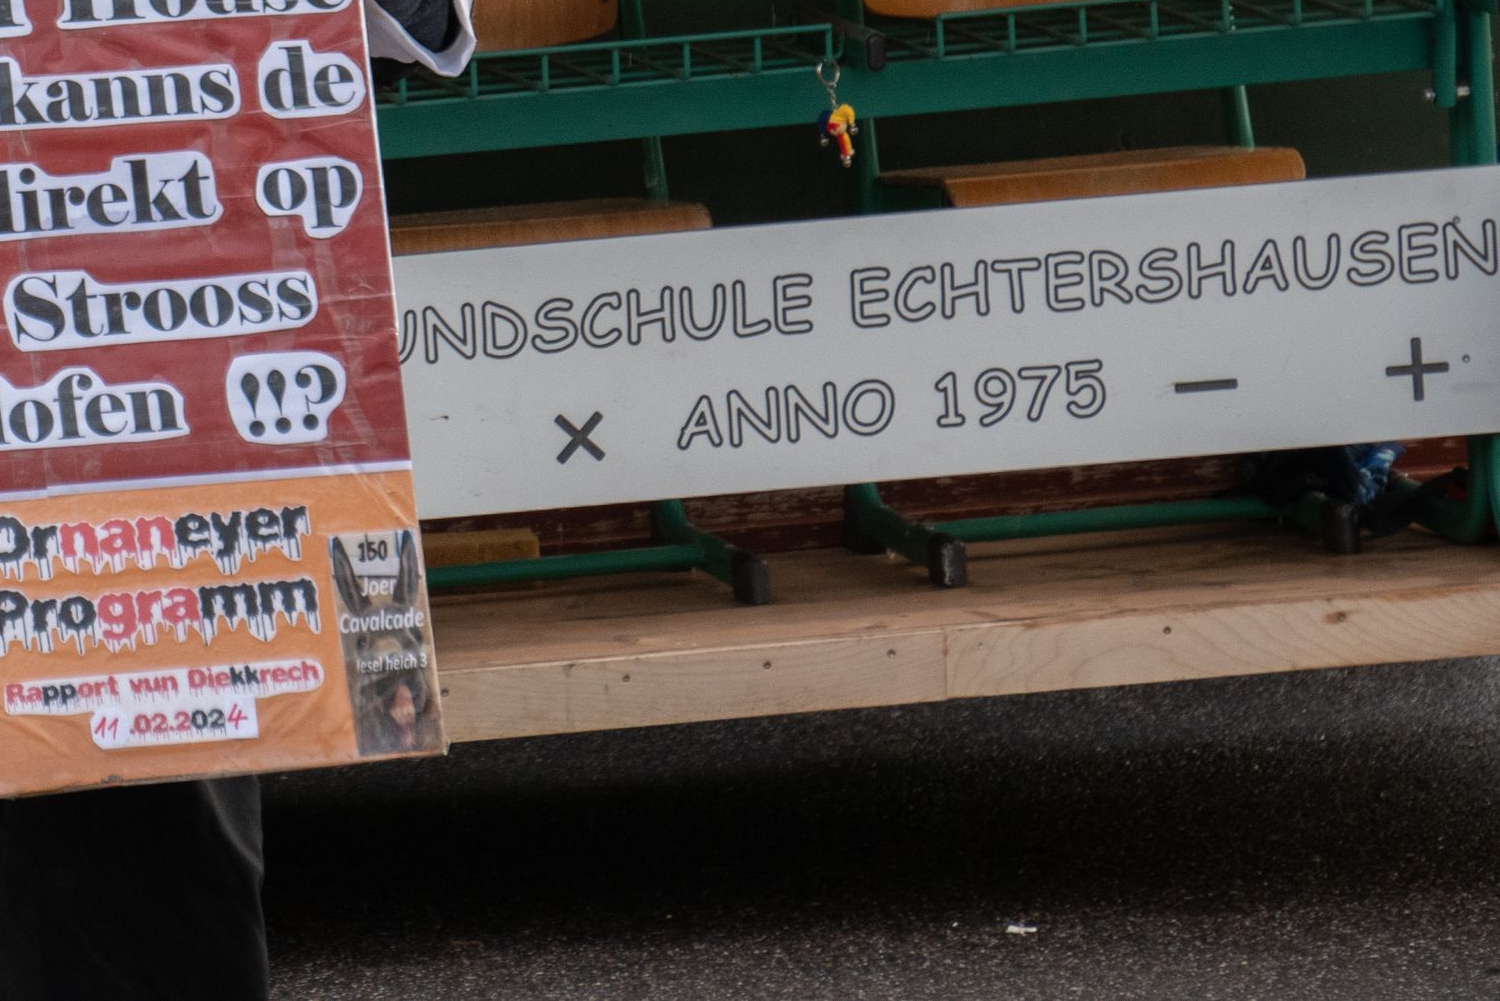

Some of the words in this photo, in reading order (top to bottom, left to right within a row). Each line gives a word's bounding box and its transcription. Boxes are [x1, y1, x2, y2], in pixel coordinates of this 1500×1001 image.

[263, 45, 357, 113] de
[262, 163, 359, 235] op
[849, 218, 1498, 329] ECHTERSHAUSEN
[13, 273, 315, 344] Strooss
[238, 360, 338, 440] !!?
[677, 378, 897, 452] ANNO
[934, 359, 1107, 429] 1975
[357, 540, 388, 562] 150
[340, 607, 425, 634] Cavalcade
[361, 577, 397, 597] Joer
[5, 676, 118, 713] Rapport
[129, 673, 180, 702] vun
[187, 661, 320, 698] Diekkrech
[385, 654, 417, 671] heich
